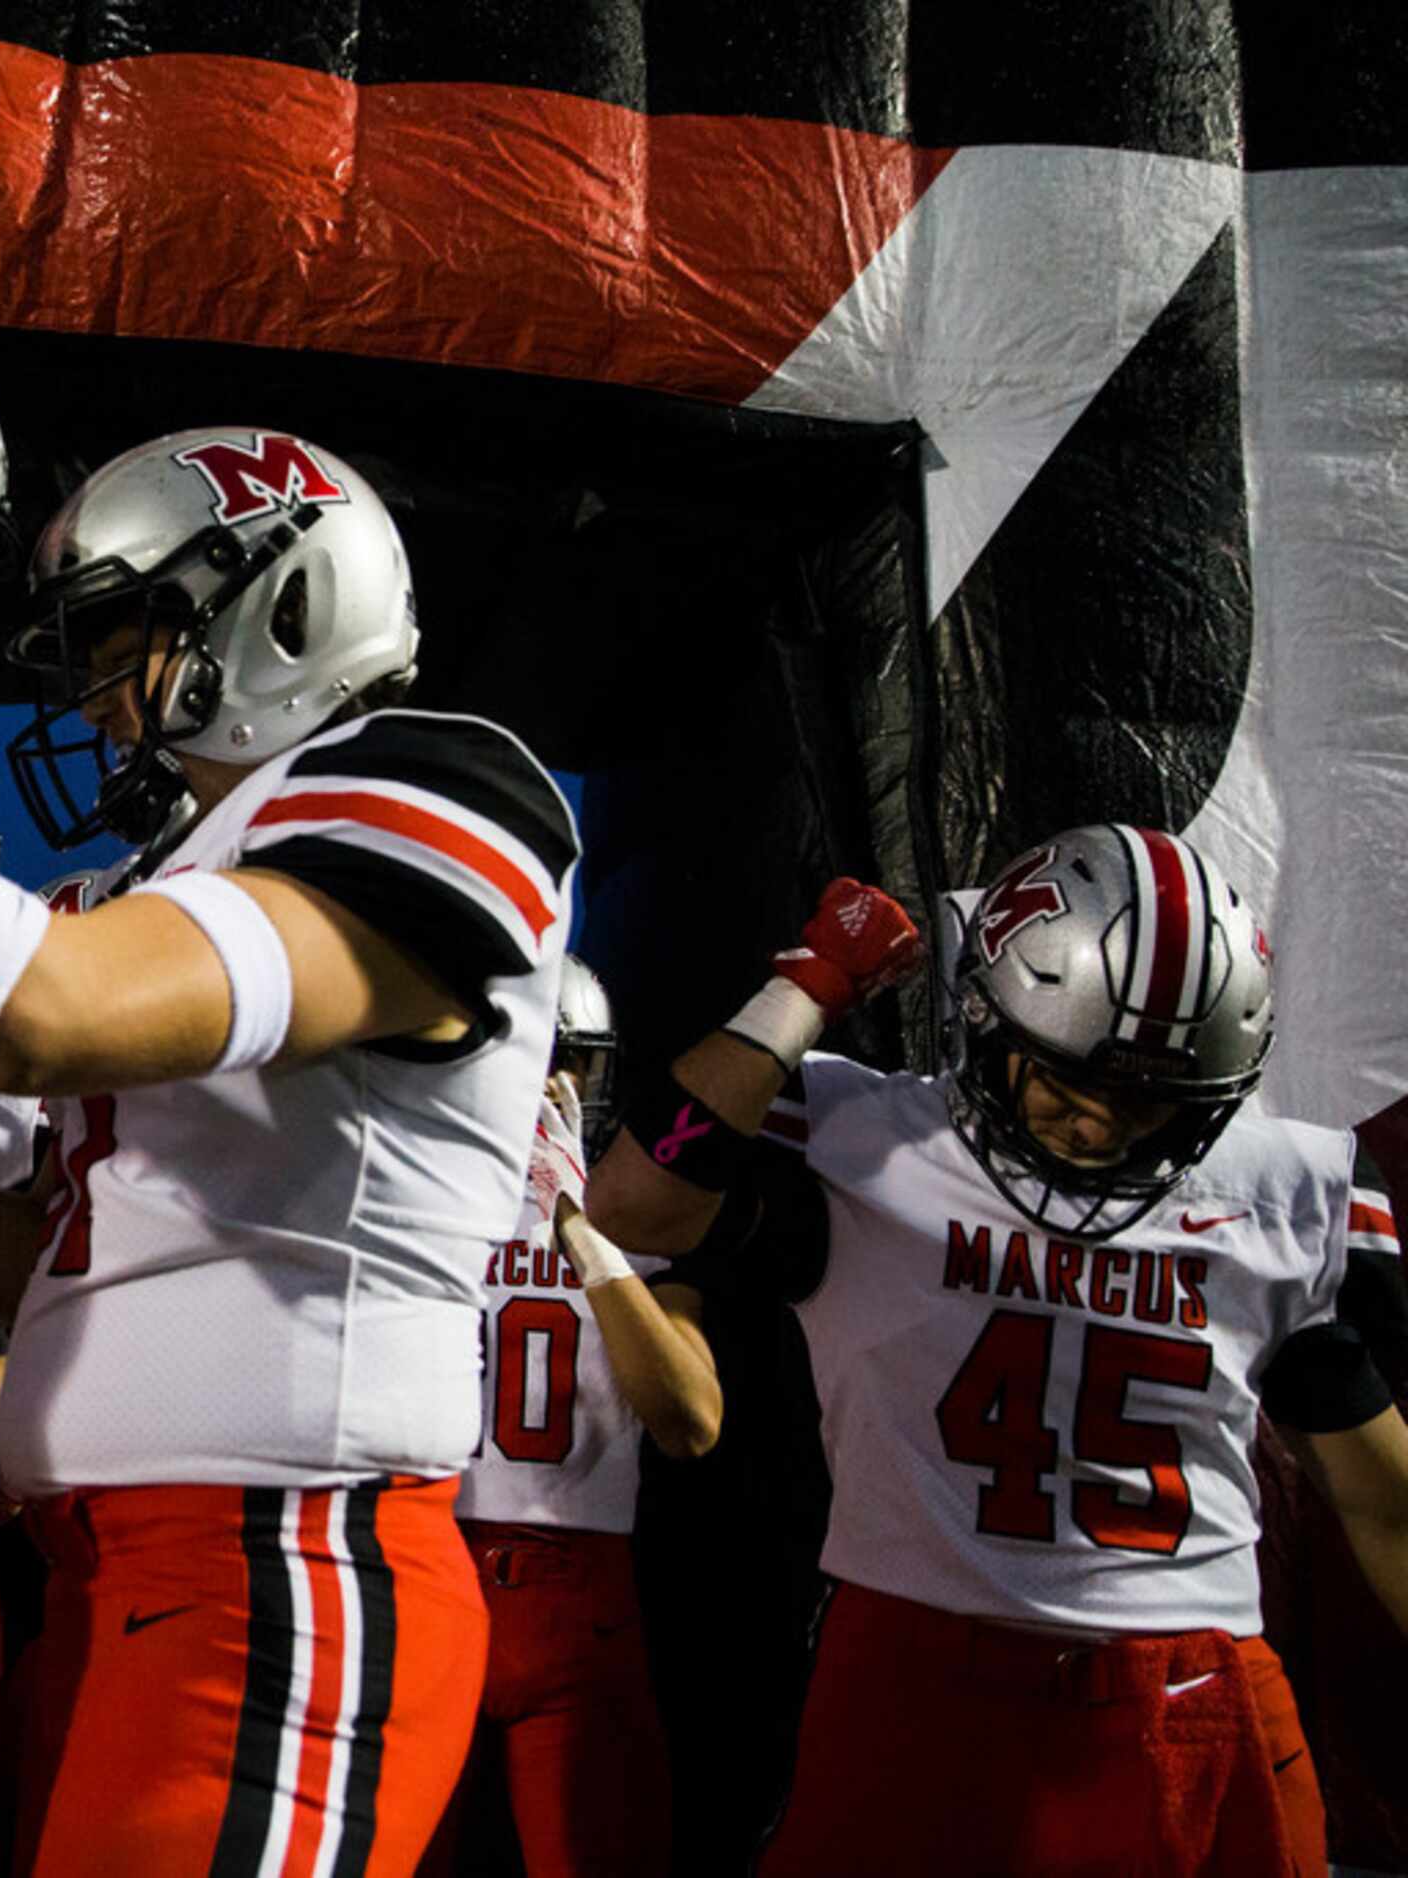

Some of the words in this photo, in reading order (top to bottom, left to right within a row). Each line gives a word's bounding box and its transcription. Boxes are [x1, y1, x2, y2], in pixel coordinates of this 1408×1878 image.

[172, 432, 351, 527] M
[978, 845, 1070, 967] M
[943, 1218, 1208, 1330] MARCUS
[480, 1297, 581, 1465] 0
[935, 1308, 1213, 1558] 45
